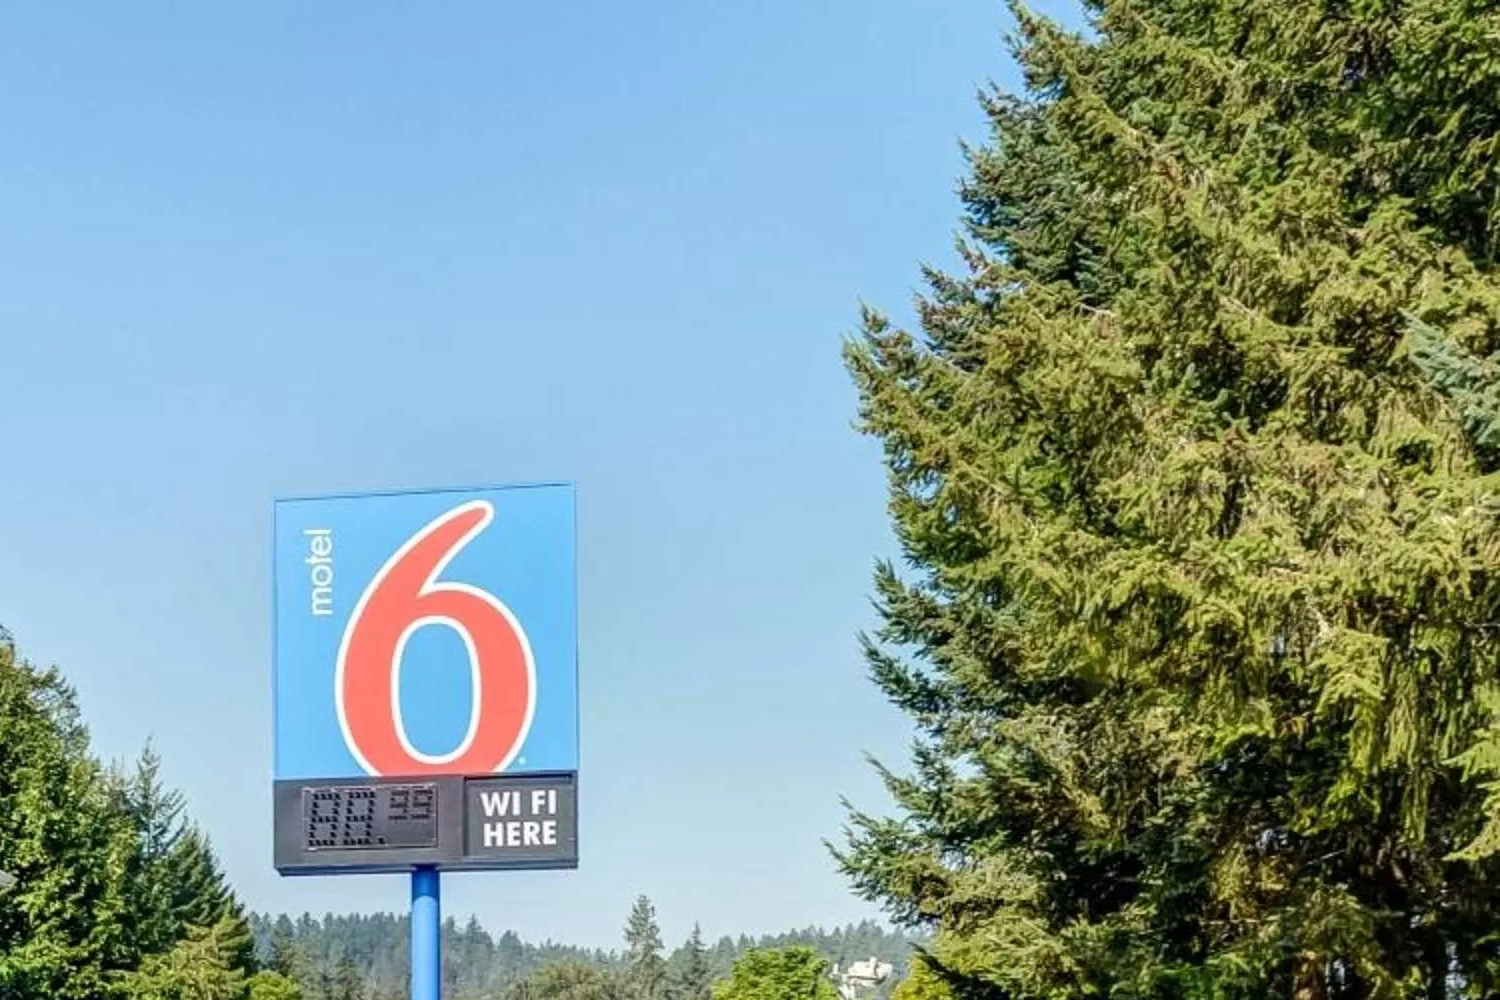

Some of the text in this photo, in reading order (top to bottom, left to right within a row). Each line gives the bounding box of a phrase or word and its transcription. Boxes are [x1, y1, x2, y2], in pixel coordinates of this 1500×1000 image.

[304, 528, 333, 615] motel
[335, 499, 537, 777] 6
[480, 789, 557, 816] WI FI
[483, 820, 557, 847] HERE
